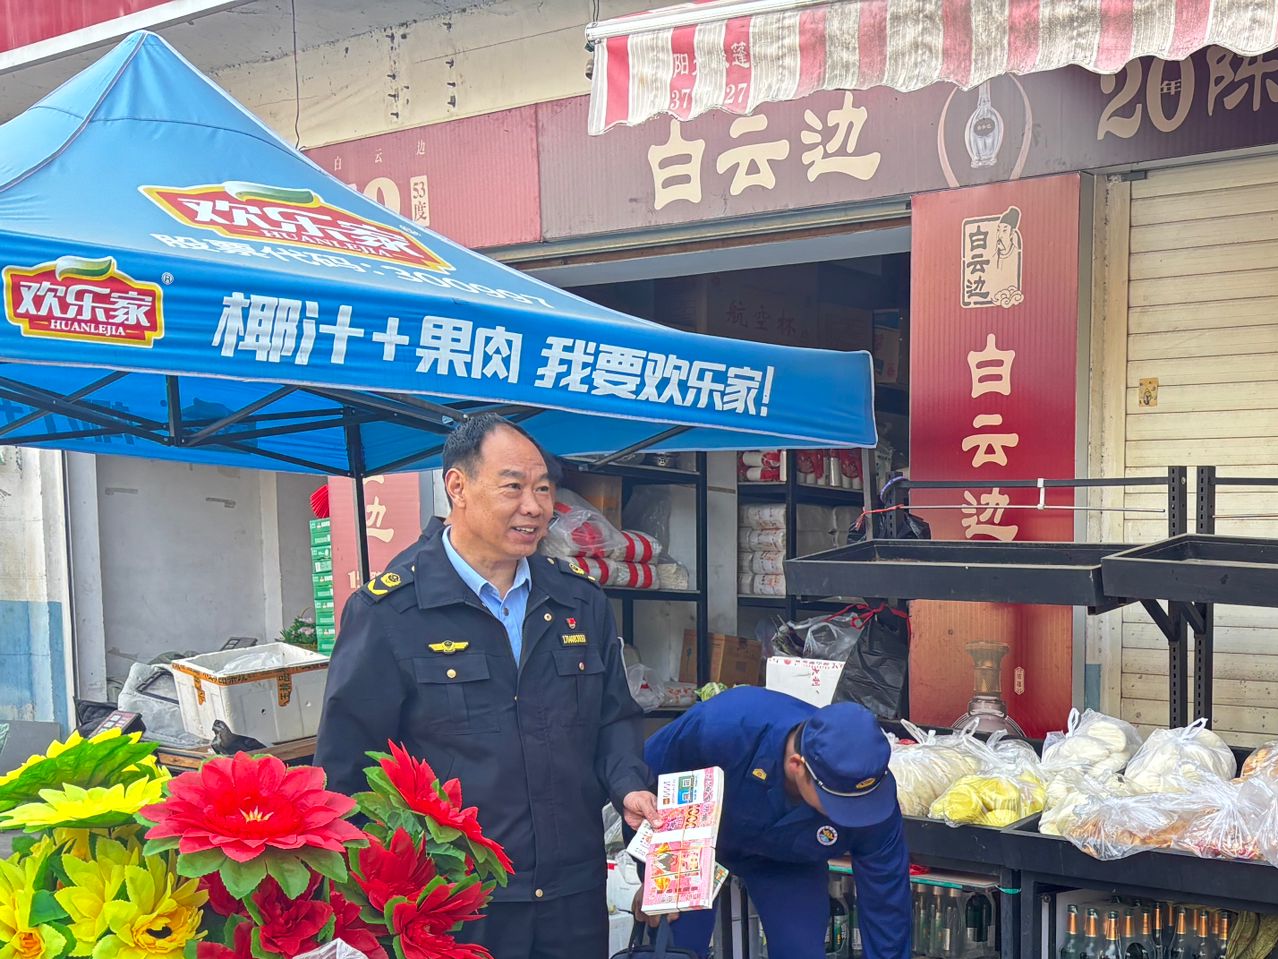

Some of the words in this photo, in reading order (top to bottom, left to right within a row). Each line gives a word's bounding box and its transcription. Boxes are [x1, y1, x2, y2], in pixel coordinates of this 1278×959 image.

[334, 139, 426, 171] 白云边
[648, 90, 881, 210] 白云边
[177, 199, 426, 260] 欢乐家
[261, 228, 392, 257] HUANLEJIA
[965, 225, 990, 299] 白云边
[16, 280, 153, 328] 欢乐家
[50, 319, 126, 336] HUANLEJIA
[961, 333, 1020, 542] 白云边
